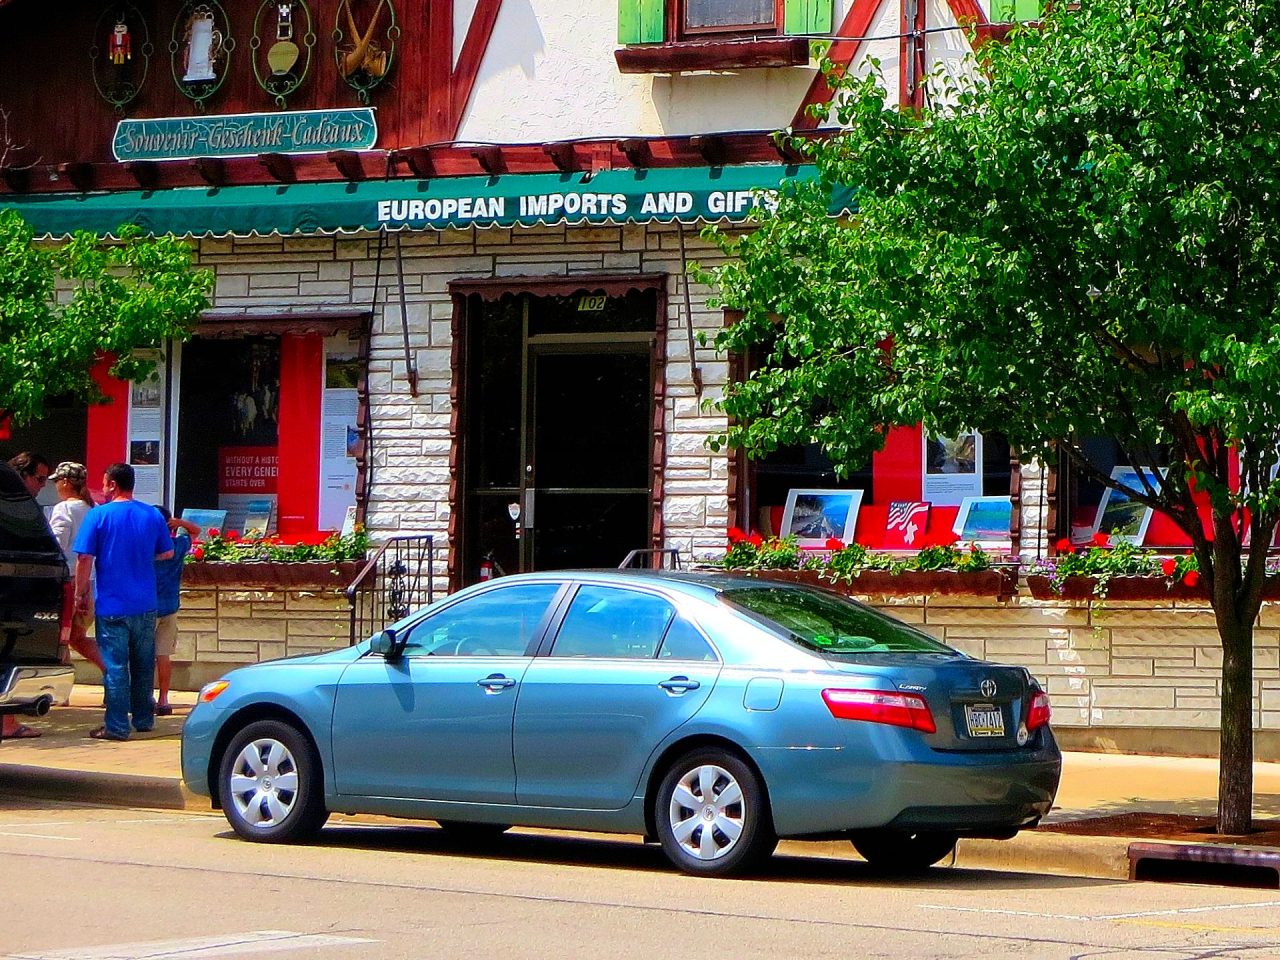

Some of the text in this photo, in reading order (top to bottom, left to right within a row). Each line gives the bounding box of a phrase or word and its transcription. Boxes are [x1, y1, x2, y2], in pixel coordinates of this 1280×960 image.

[378, 196, 505, 221] EUROPEAN
[520, 193, 627, 216] IMPORTS
[641, 192, 693, 214] AND
[582, 297, 604, 310] 102
[225, 456, 253, 464] WITHOUT
[255, 456, 259, 464] A
[225, 466, 279, 477] EVERY GENE
